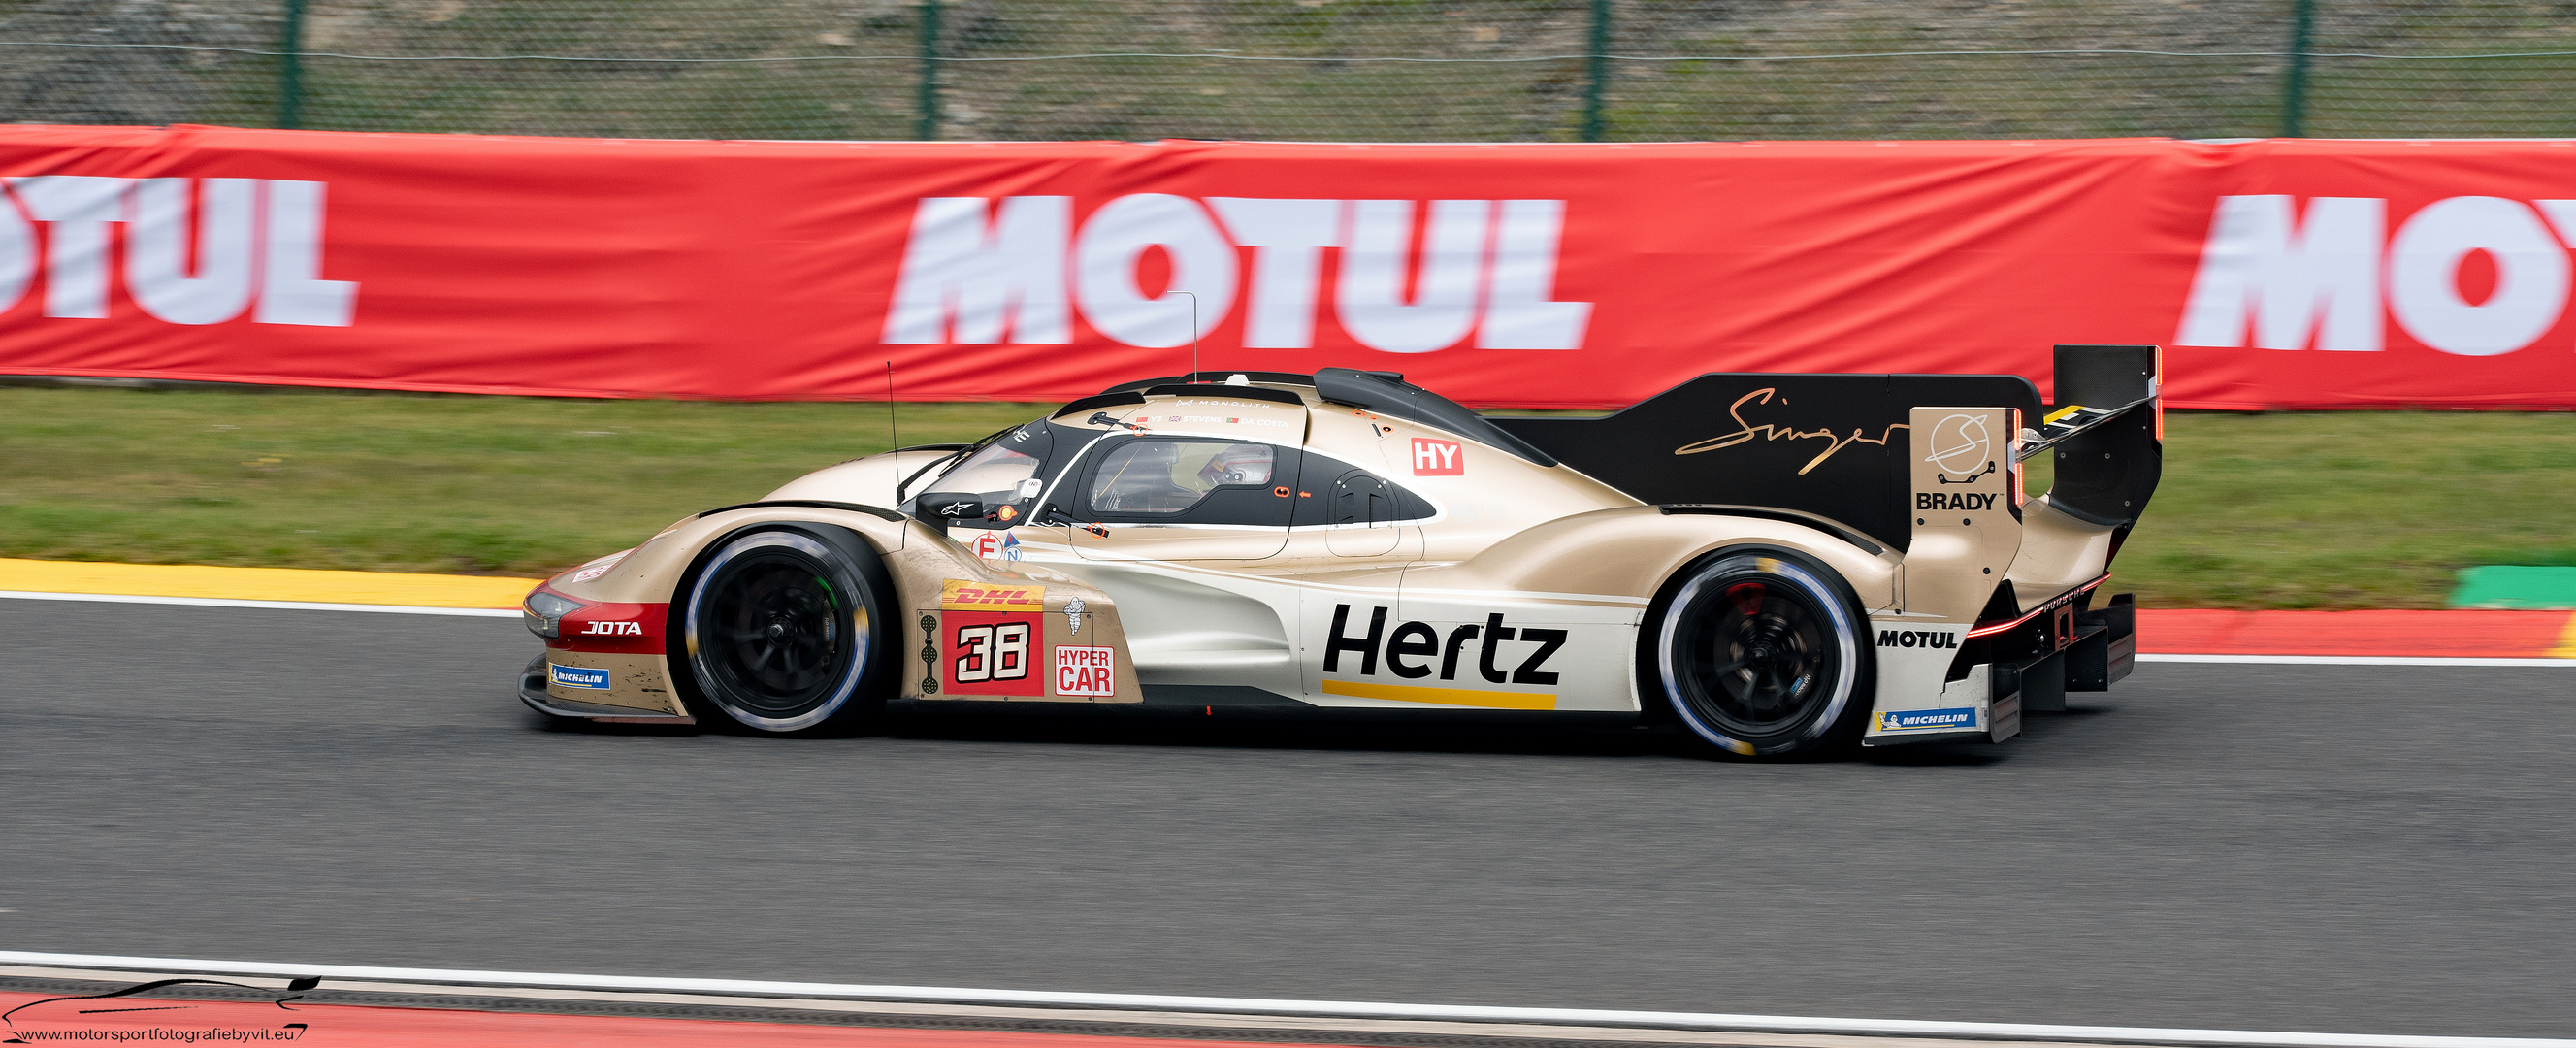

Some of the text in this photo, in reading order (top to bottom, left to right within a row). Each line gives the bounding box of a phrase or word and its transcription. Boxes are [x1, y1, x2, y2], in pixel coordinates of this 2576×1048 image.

[0, 176, 361, 327] TUL
[879, 193, 1595, 353] MOTUL
[1199, 400, 1271, 409] MONOLITH
[1183, 415, 1223, 424] STEVENS
[1257, 419, 1288, 428] COSTA
[1675, 388, 1910, 475] Singer
[1415, 442, 1458, 470] HY
[1915, 493, 1998, 510] BRADY
[1007, 550, 1018, 561] N
[956, 588, 1030, 605] DHL
[581, 621, 642, 635] JOTA
[1323, 604, 1568, 685] Hertz
[1877, 630, 1958, 649] MOTUL
[955, 621, 1030, 683] 38
[1058, 649, 1109, 666] HYPER
[558, 671, 603, 684] MICHELIN
[1059, 667, 1111, 692] CAR
[1903, 713, 1968, 725] MICHELIN
